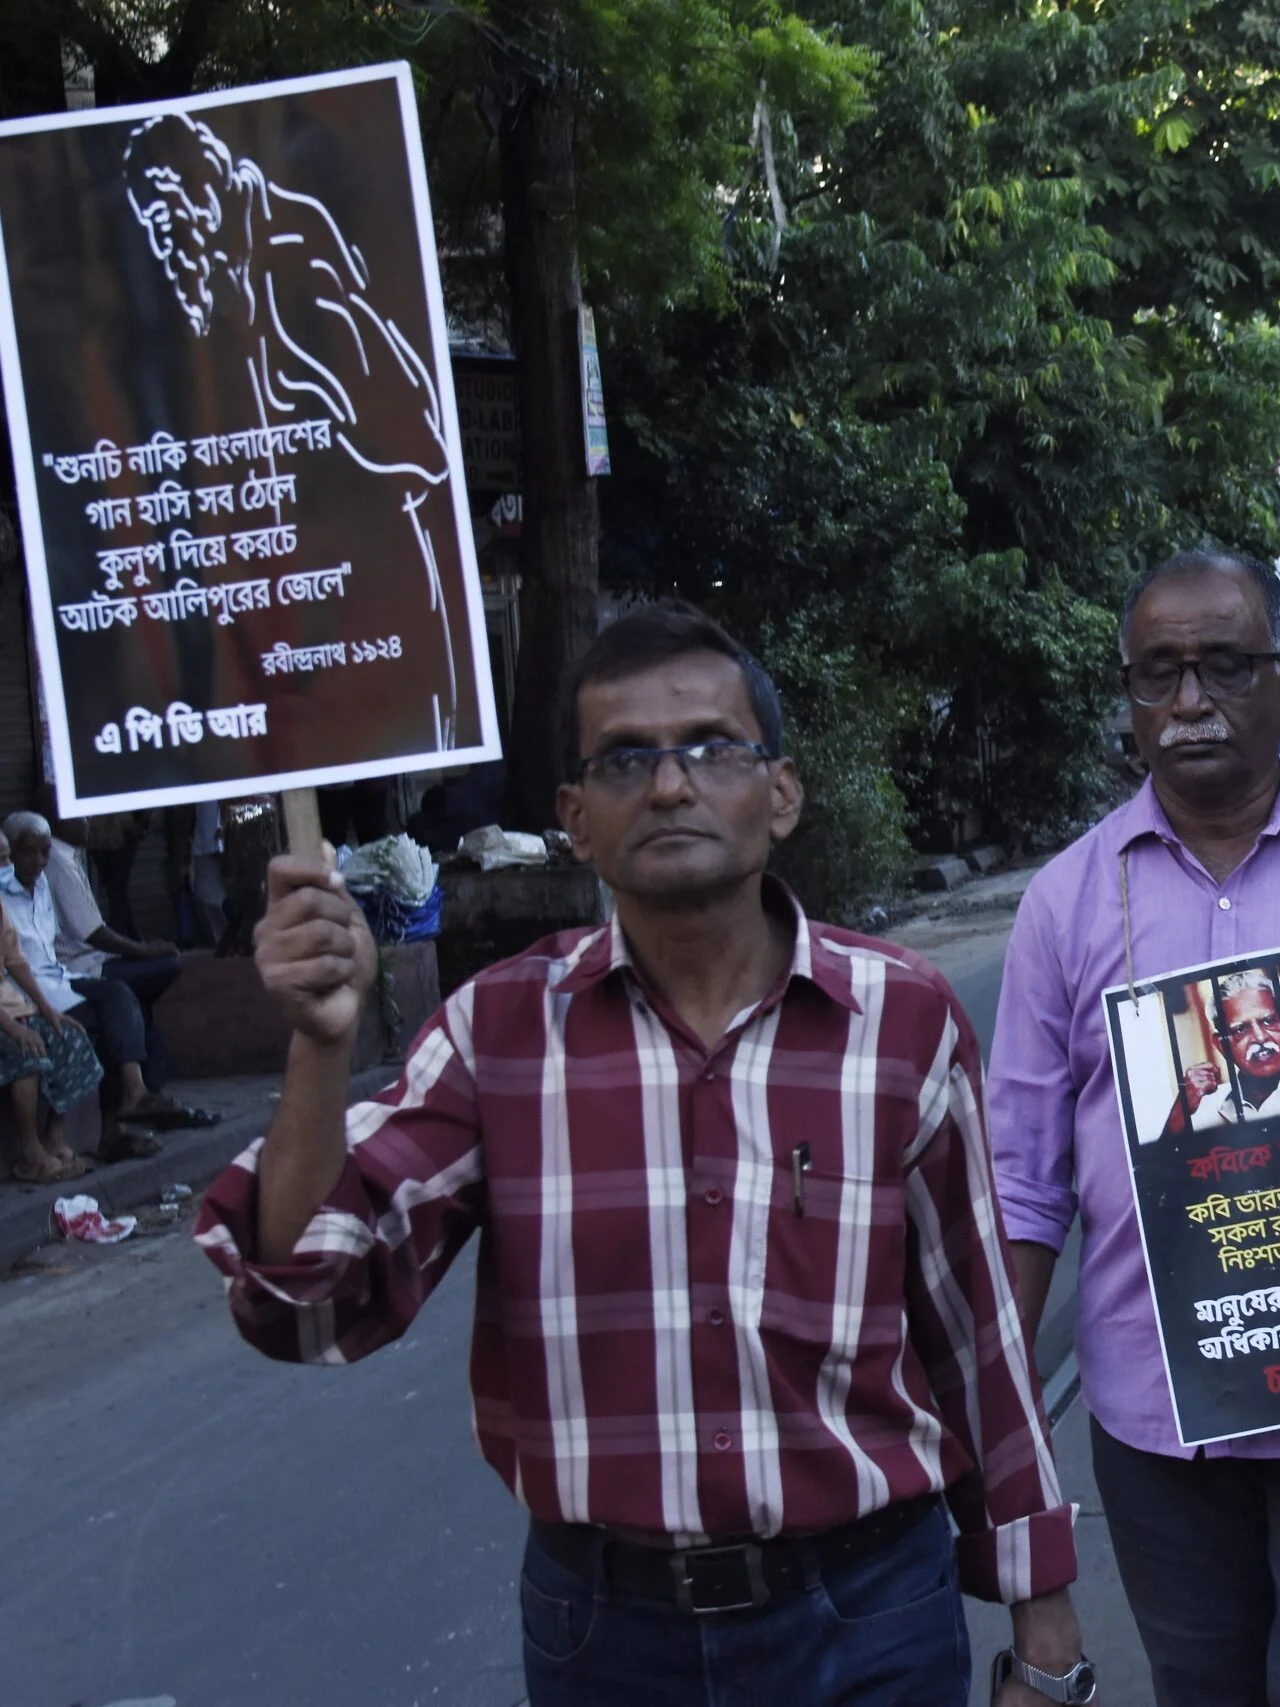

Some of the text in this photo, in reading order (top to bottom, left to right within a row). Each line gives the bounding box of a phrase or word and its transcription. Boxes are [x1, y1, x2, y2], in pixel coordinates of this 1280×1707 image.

[126, 430, 187, 475] নাকি
[191, 419, 331, 467] বাংলাদেশের
[85, 467, 296, 531] গান হাসি সব ঠেলে
[97, 523, 298, 588] কুলুপ দিয়ে করচে
[59, 592, 137, 633] আটক
[142, 577, 270, 626] আলিপুরের
[262, 635, 403, 677] রবীন্দ্রনাথ ১৯২৪
[94, 701, 267, 754] এ পি ডি আর
[1187, 1144, 1271, 1183] কবিকে
[1186, 1194, 1231, 1224] কবি
[1208, 1217, 1267, 1245] সকল
